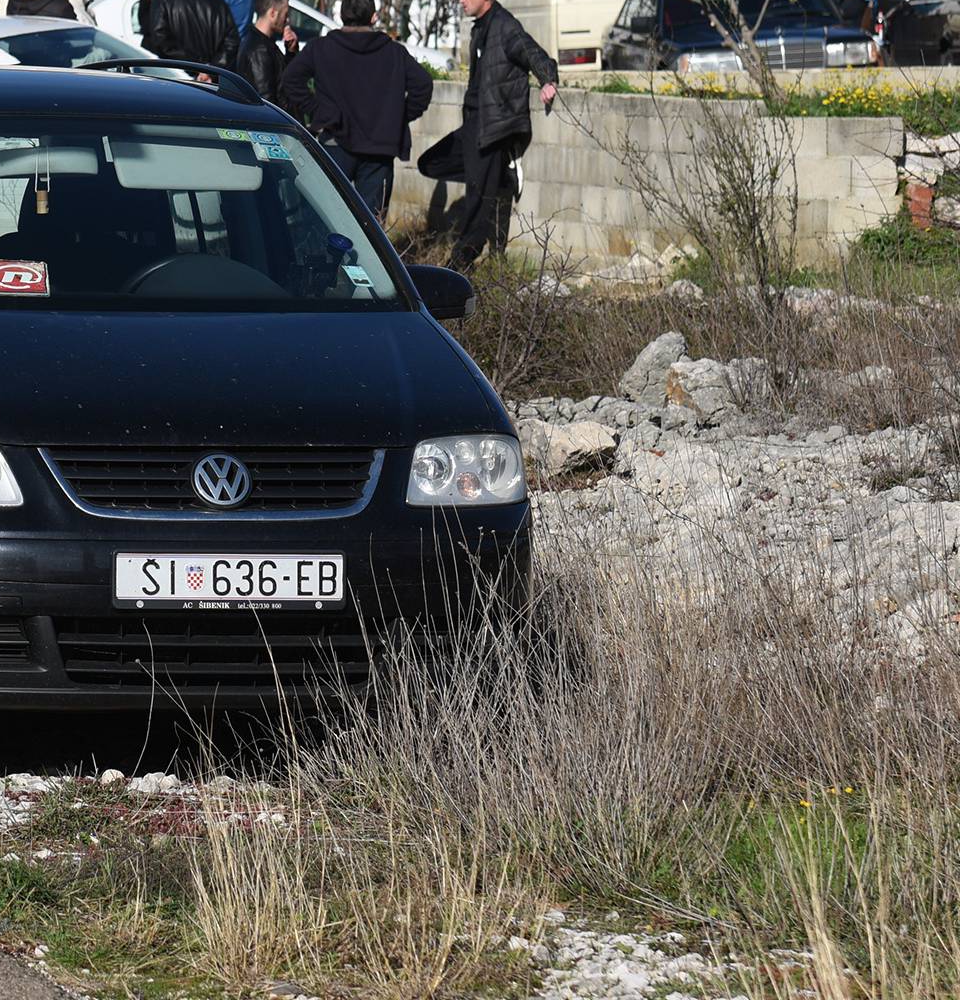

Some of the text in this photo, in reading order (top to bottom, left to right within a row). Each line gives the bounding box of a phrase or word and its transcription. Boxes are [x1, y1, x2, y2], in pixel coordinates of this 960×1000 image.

[141, 558, 337, 596] ŠI 636-EB
[198, 601, 230, 609] ŠIBENIK
